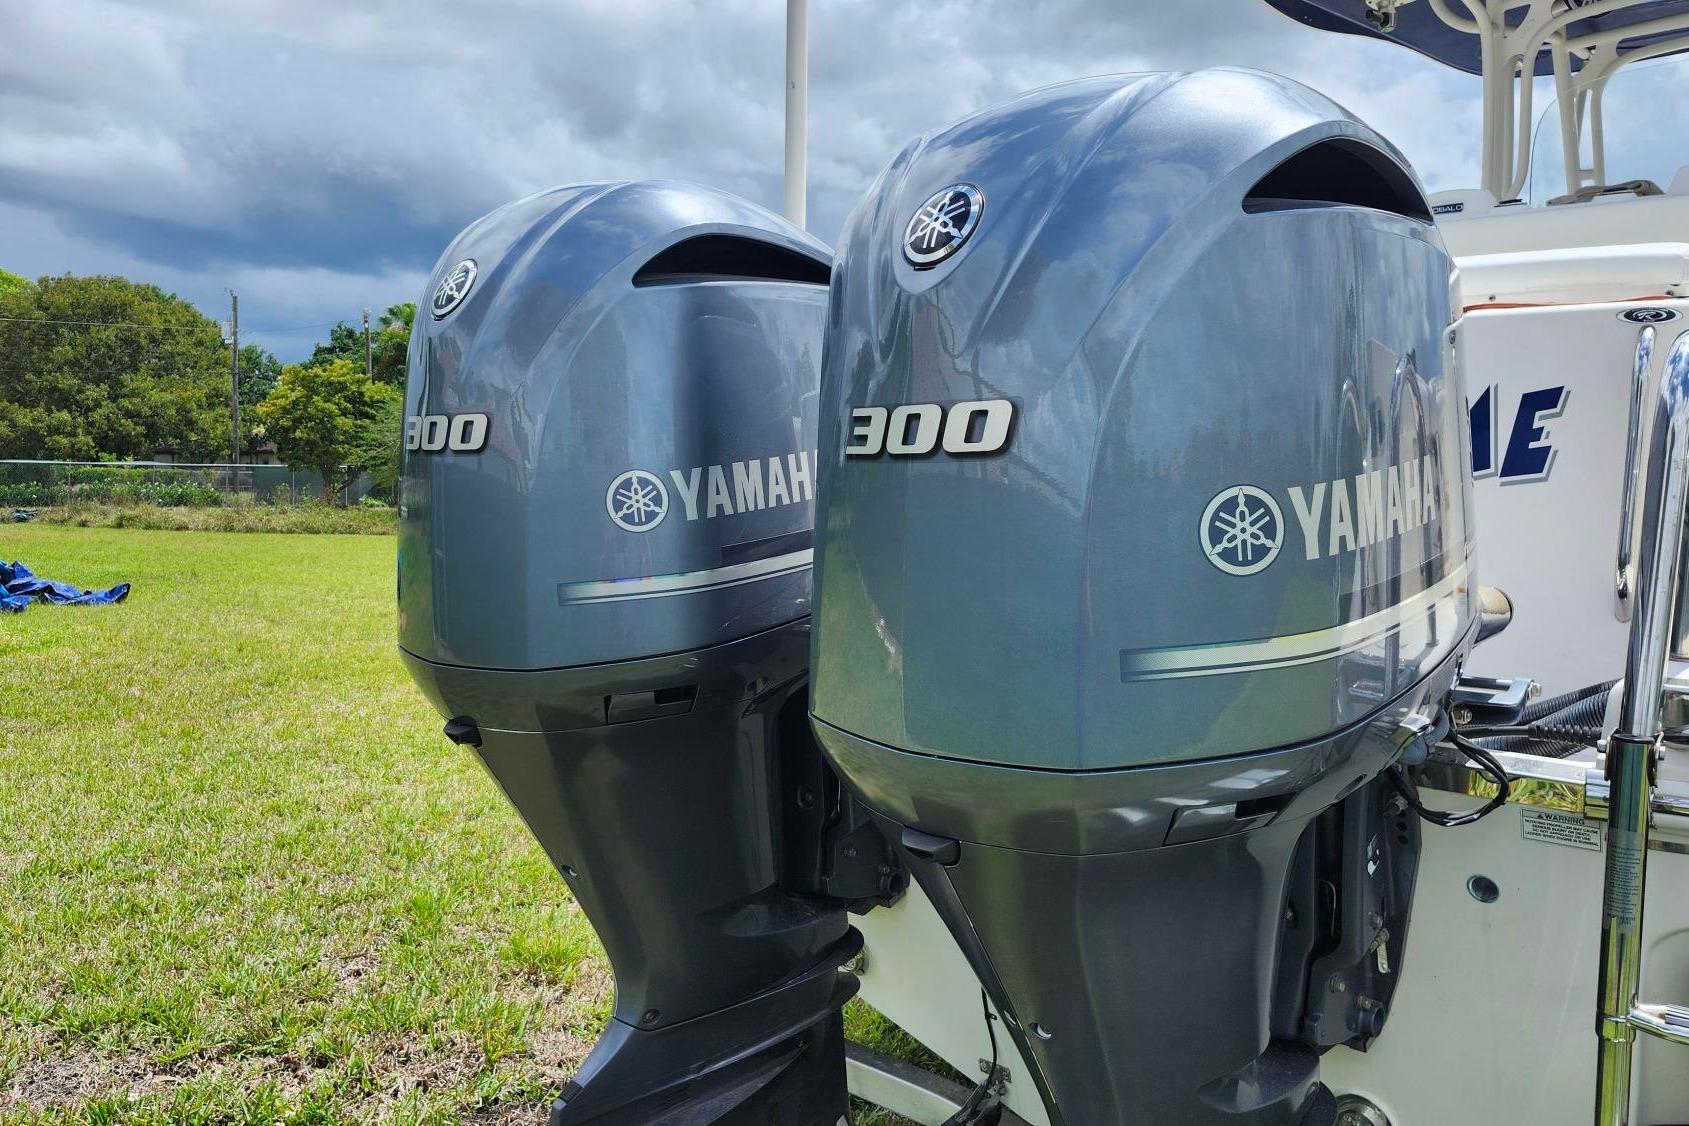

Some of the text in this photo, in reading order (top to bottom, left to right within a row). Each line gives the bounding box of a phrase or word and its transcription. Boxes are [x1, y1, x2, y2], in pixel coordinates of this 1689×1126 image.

[1432, 204, 1463, 214] OBALO
[406, 413, 488, 451] 300
[845, 400, 1013, 455] 300
[670, 448, 818, 520] YAMAH
[1287, 455, 1437, 560] YAMAHA
[1544, 813, 1585, 826] WARNING
